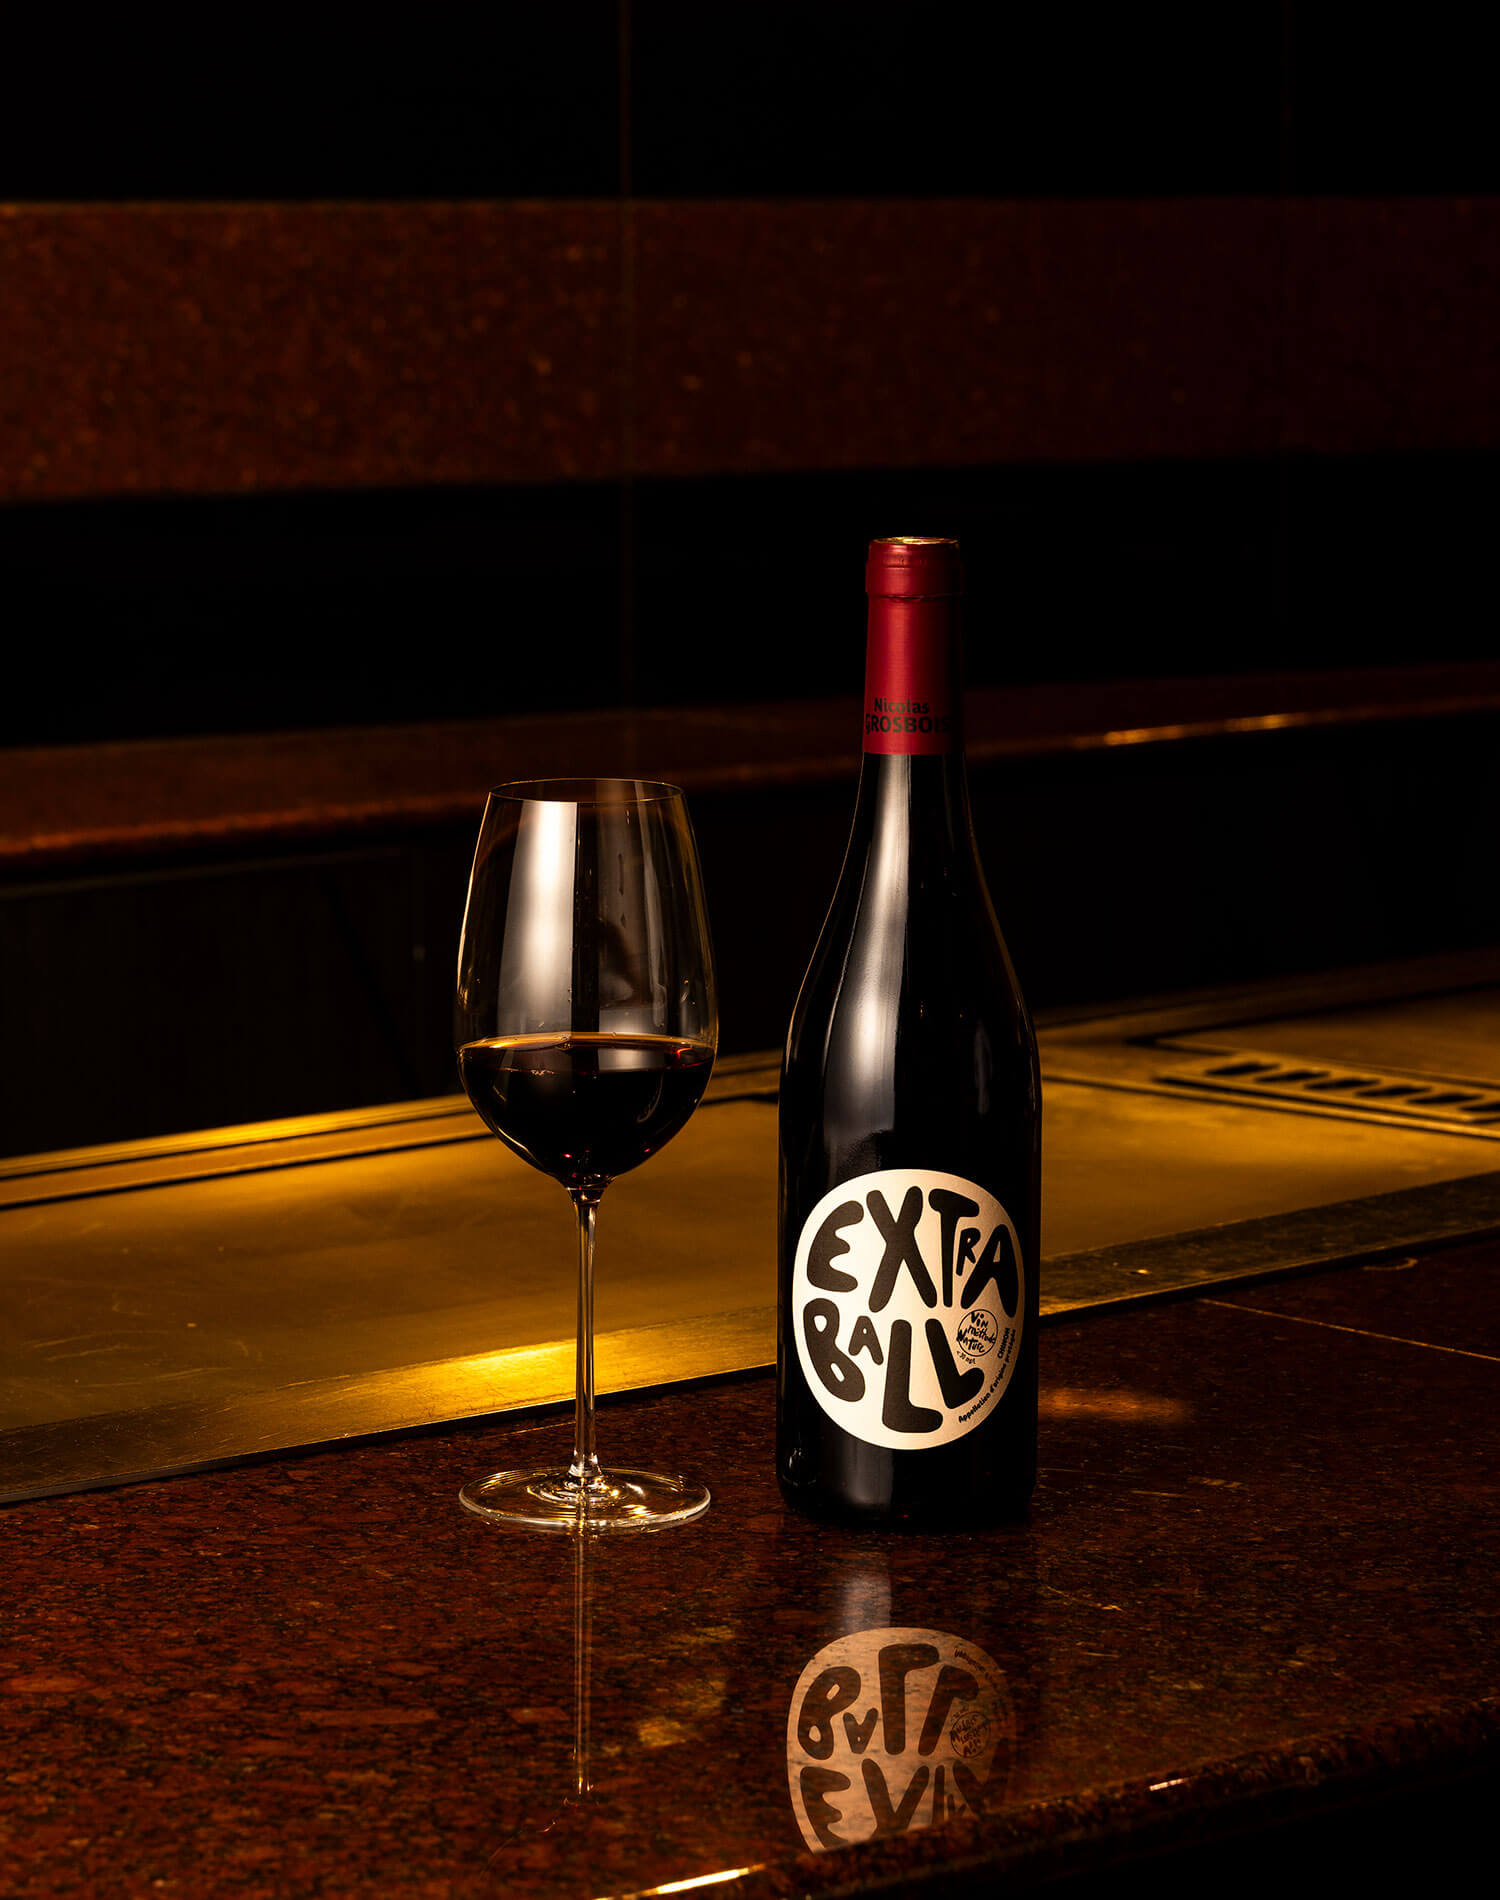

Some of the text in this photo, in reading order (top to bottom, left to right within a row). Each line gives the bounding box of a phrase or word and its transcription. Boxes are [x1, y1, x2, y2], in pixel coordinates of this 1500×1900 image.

[874, 697, 930, 714] Nicolas
[806, 1185, 1019, 1318] EXTRA
[803, 1297, 985, 1433] BALL
